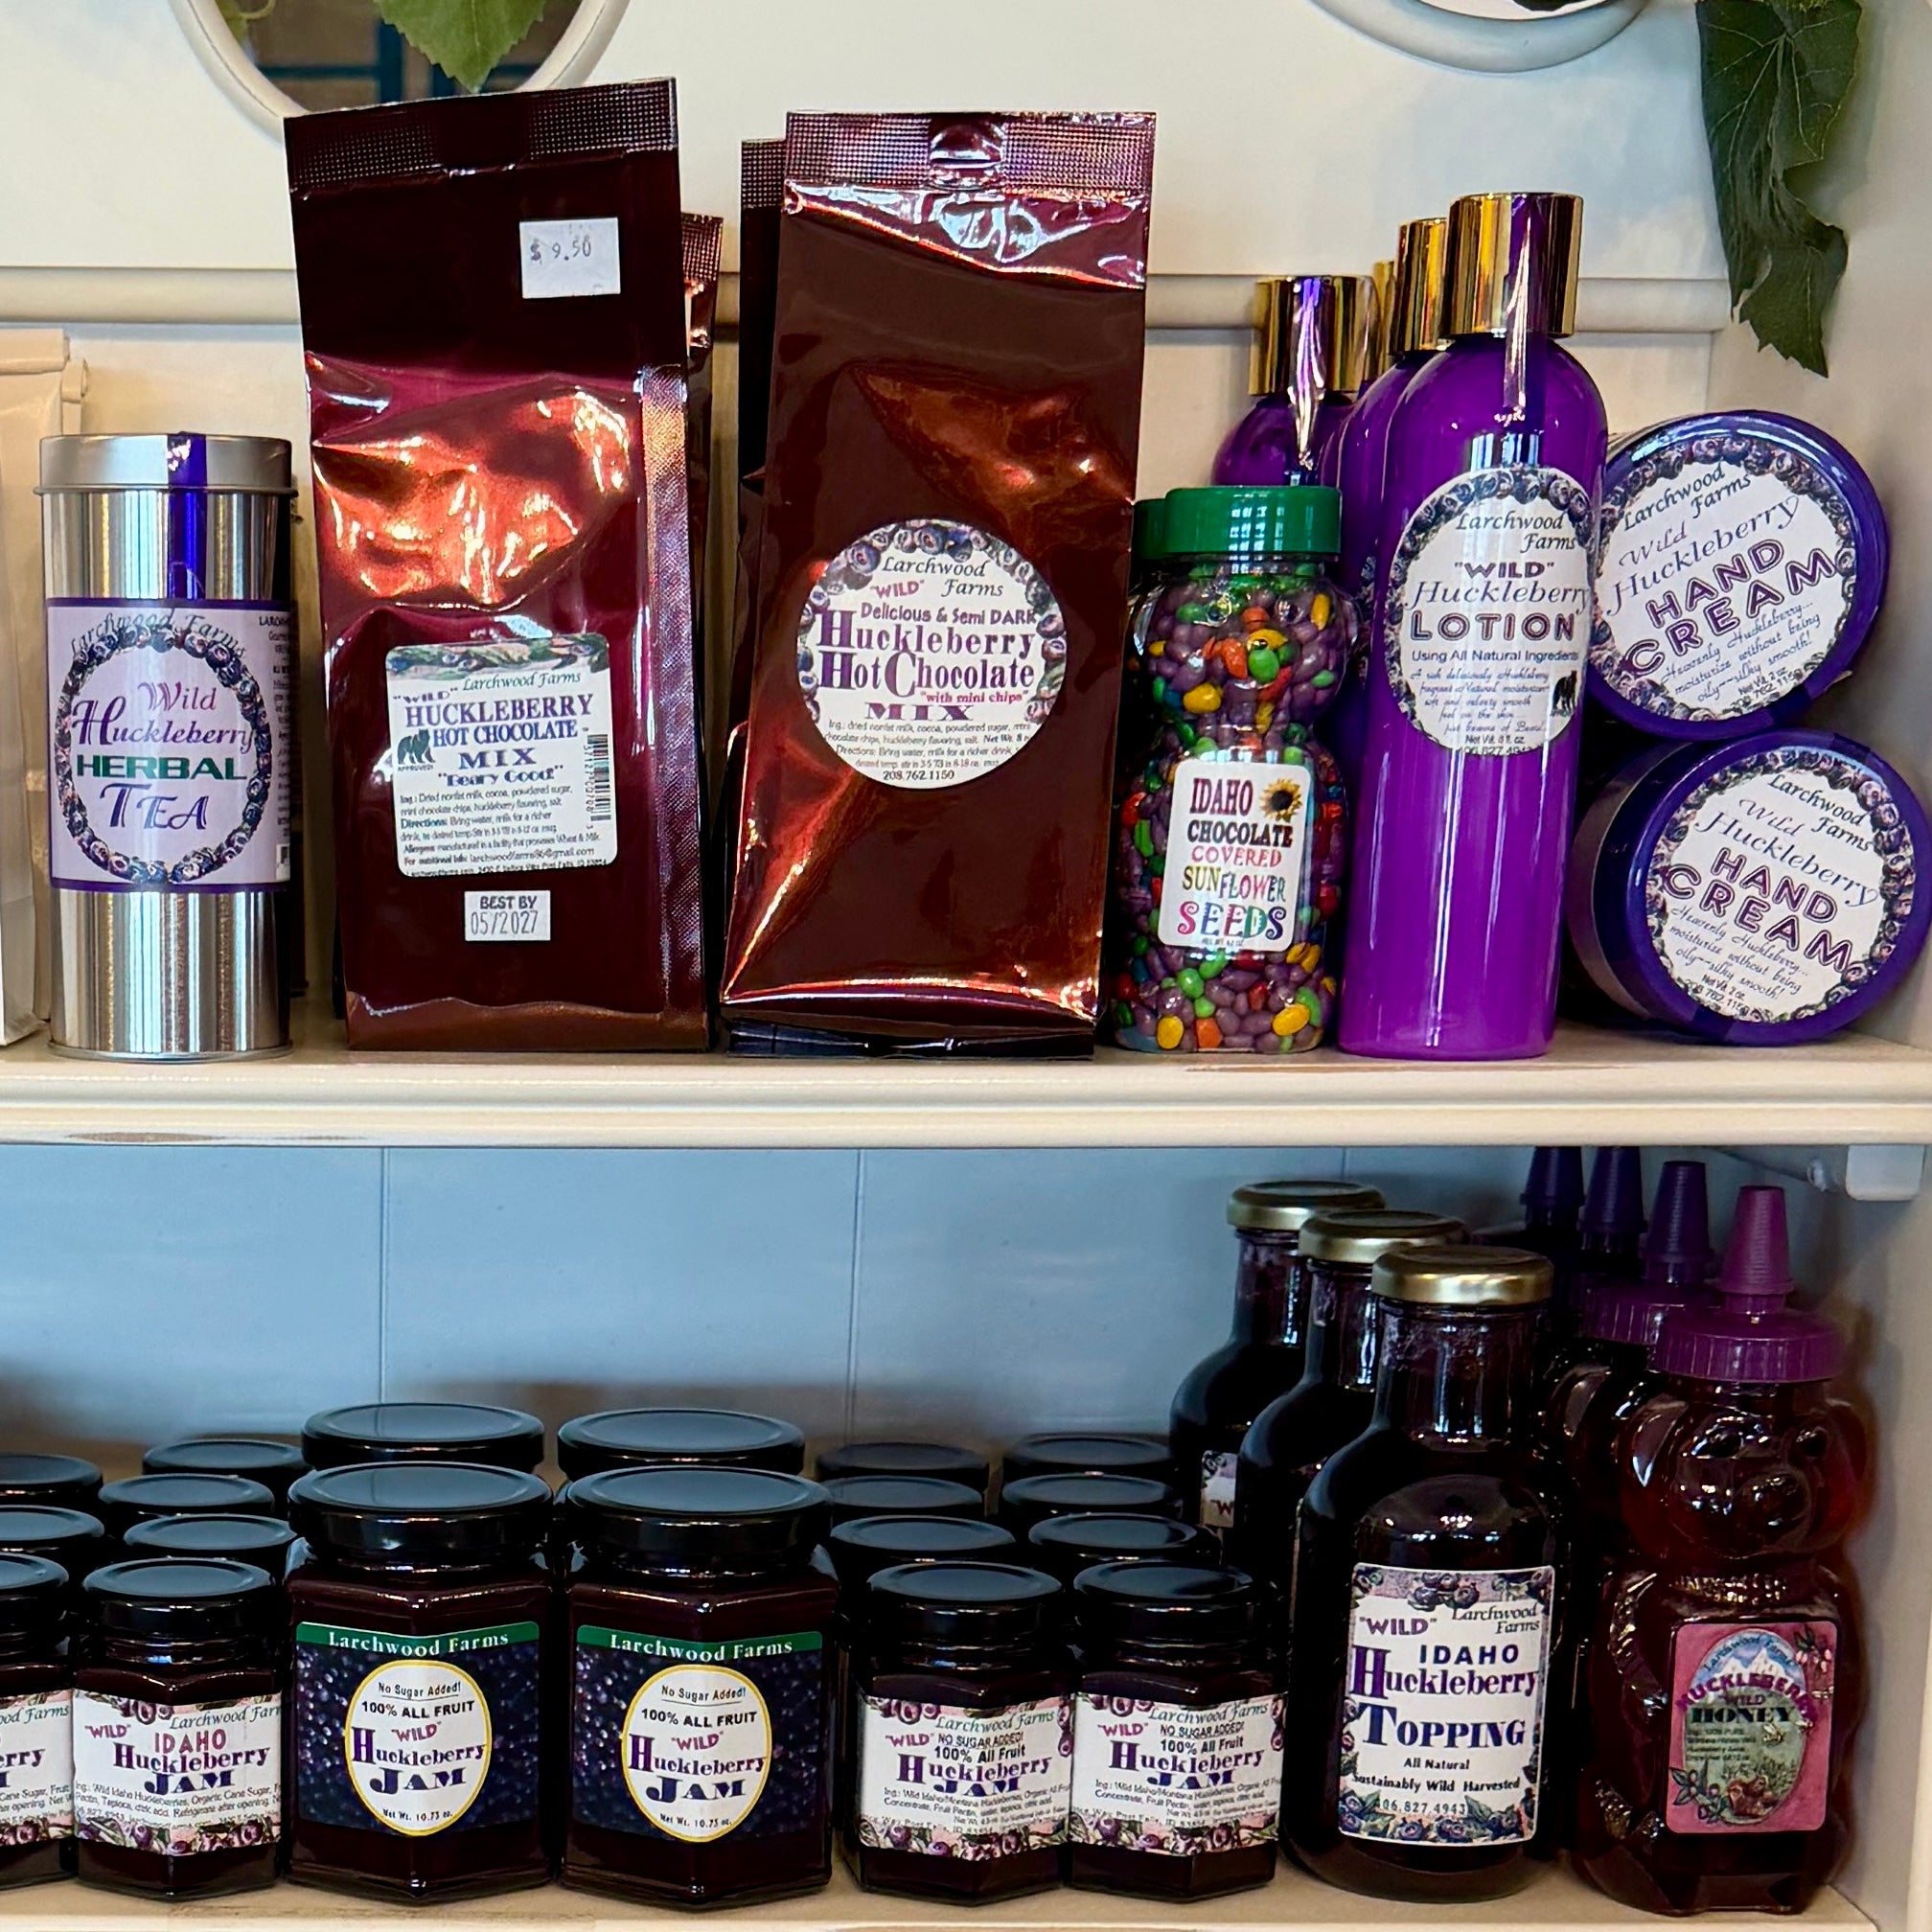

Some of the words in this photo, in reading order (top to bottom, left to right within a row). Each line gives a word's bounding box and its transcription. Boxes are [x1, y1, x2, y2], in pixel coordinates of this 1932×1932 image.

[1622, 462, 1725, 531] Larchwood
[1690, 472, 1752, 519] Farms
[1456, 510, 1566, 532] Larchwood
[1520, 534, 1576, 553] Farms
[1606, 494, 1799, 617] Huckleberry
[1618, 521, 1688, 567] Wild
[883, 556, 991, 577] Larchwood
[1455, 562, 1554, 579] "WILD"
[870, 579, 925, 599] "WILD"
[941, 579, 1003, 598] Farms
[1645, 539, 1784, 629] HAND
[1404, 581, 1590, 616] Huckleberry
[861, 602, 932, 622] Delicious
[935, 607, 948, 622] &
[952, 607, 986, 624] Semi
[990, 609, 1037, 625] DARK
[1622, 548, 1837, 677] CREAM
[71, 608, 176, 656] Larchwood
[183, 613, 246, 659] Farms
[816, 609, 1036, 659] Huckleberry
[1411, 610, 1575, 641] LOTION
[1738, 632, 1782, 662] without
[1788, 613, 1821, 635] being
[1412, 650, 1447, 663] Using
[1449, 650, 1467, 661] All
[1472, 650, 1521, 661] Natural
[1661, 642, 1721, 683] Heavenly
[463, 674, 537, 691] Larchwood
[538, 673, 581, 689] Farms
[817, 651, 881, 690] Hot
[885, 652, 1035, 698] Chocolate
[138, 680, 217, 711] Wild
[920, 691, 953, 703] "with
[956, 692, 985, 703] mini
[988, 690, 1029, 704] chips"
[406, 694, 593, 727] HUCKLEBERRY
[864, 702, 974, 721] MIX
[72, 696, 255, 754] Huckleberry
[433, 728, 470, 748] HOT
[473, 719, 577, 744] CHOCOLATE
[77, 755, 247, 780] HERBAL
[458, 748, 537, 770] MIX
[100, 783, 208, 830] TEA
[1189, 777, 1254, 816] IDAHO
[1768, 773, 1869, 828] Larchwood
[1738, 798, 1805, 838] Wild
[1187, 819, 1293, 848] CHOCOLATE
[1811, 816, 1874, 852] Farms
[1191, 845, 1281, 867] COVERED
[1695, 812, 1880, 908] Huckleberry
[1182, 866, 1286, 903] SUNFLOWER
[1710, 847, 1837, 923] HAND
[480, 896, 515, 909] BEST
[518, 896, 537, 909] BY
[471, 910, 539, 935] 05/2027
[1177, 901, 1286, 940] SEEDS
[1664, 863, 1853, 973] CREAM
[1670, 905, 1728, 941] Heavenly
[1728, 953, 1769, 976] without
[1773, 968, 1803, 996] being
[1452, 1604, 1537, 1621] Larchwood
[1359, 1617, 1438, 1636] "WILD"
[1495, 1620, 1540, 1635] Farms
[329, 1632, 440, 1657] Larchwood
[449, 1632, 509, 1652] Farms
[610, 1635, 724, 1662] Larchwood
[733, 1641, 793, 1659] Farms
[1419, 1644, 1519, 1665] IDAHO
[1350, 1644, 1537, 1699] Huckleberry
[378, 1682, 391, 1693] No
[395, 1684, 424, 1699] Sugar
[427, 1682, 461, 1695] Added!
[661, 1686, 675, 1696] No
[678, 1689, 709, 1702] Sugar
[712, 1687, 746, 1700] Added!
[24, 1706, 69, 1724] Farms
[170, 1707, 246, 1730] Larchwood
[361, 1700, 398, 1716] 100%
[402, 1707, 429, 1718] ALL
[434, 1700, 474, 1717] FRUIT
[641, 1709, 678, 1725] 100%
[683, 1715, 712, 1728] ALL
[717, 1712, 757, 1727] FRUIT
[1149, 1707, 1227, 1724] Larchwood
[1230, 1701, 1269, 1721] Farms
[1691, 1707, 1790, 1723] HONEY
[84, 1725, 131, 1739] "WILD"
[391, 1721, 442, 1742] "WILD"
[935, 1714, 1013, 1734] Larchwood
[1017, 1710, 1055, 1730] Farms
[1097, 1722, 1148, 1737] "WILD"
[1160, 1724, 1175, 1736] NO
[1178, 1725, 1211, 1739] SUGAR
[1357, 1702, 1525, 1749] TOPPING
[155, 1728, 226, 1754] IDAHO
[351, 1726, 487, 1766] Huckleberry
[671, 1731, 724, 1750] "WILD"
[885, 1733, 935, 1747] "WILD"
[938, 1734, 953, 1745] NO
[956, 1735, 991, 1749] SUGAR
[1161, 1738, 1197, 1755] 100%
[1201, 1740, 1215, 1755] All
[1218, 1735, 1244, 1751] Fruit
[113, 1742, 270, 1773] Huckleberry
[628, 1734, 768, 1776] Huckleberry
[934, 1745, 973, 1763] 100%
[978, 1749, 995, 1763] All
[999, 1744, 1025, 1760] Fruit
[1108, 1739, 1265, 1772] Huckleberry
[1404, 1758, 1421, 1768] All
[1425, 1759, 1469, 1770] Natural
[369, 1767, 466, 1795] JAM
[896, 1753, 1052, 1784] Huckleberry
[1147, 1768, 1235, 1789] JAM
[144, 1769, 235, 1795] JAM
[646, 1776, 746, 1804] JAM
[933, 1777, 1021, 1797] JAM
[1426, 1780, 1455, 1792] Wild
[1463, 1777, 1520, 1792] Harvested
[383, 1808, 396, 1819] Net
[660, 1813, 673, 1824] Net
[694, 1817, 718, 1828] 10.75
